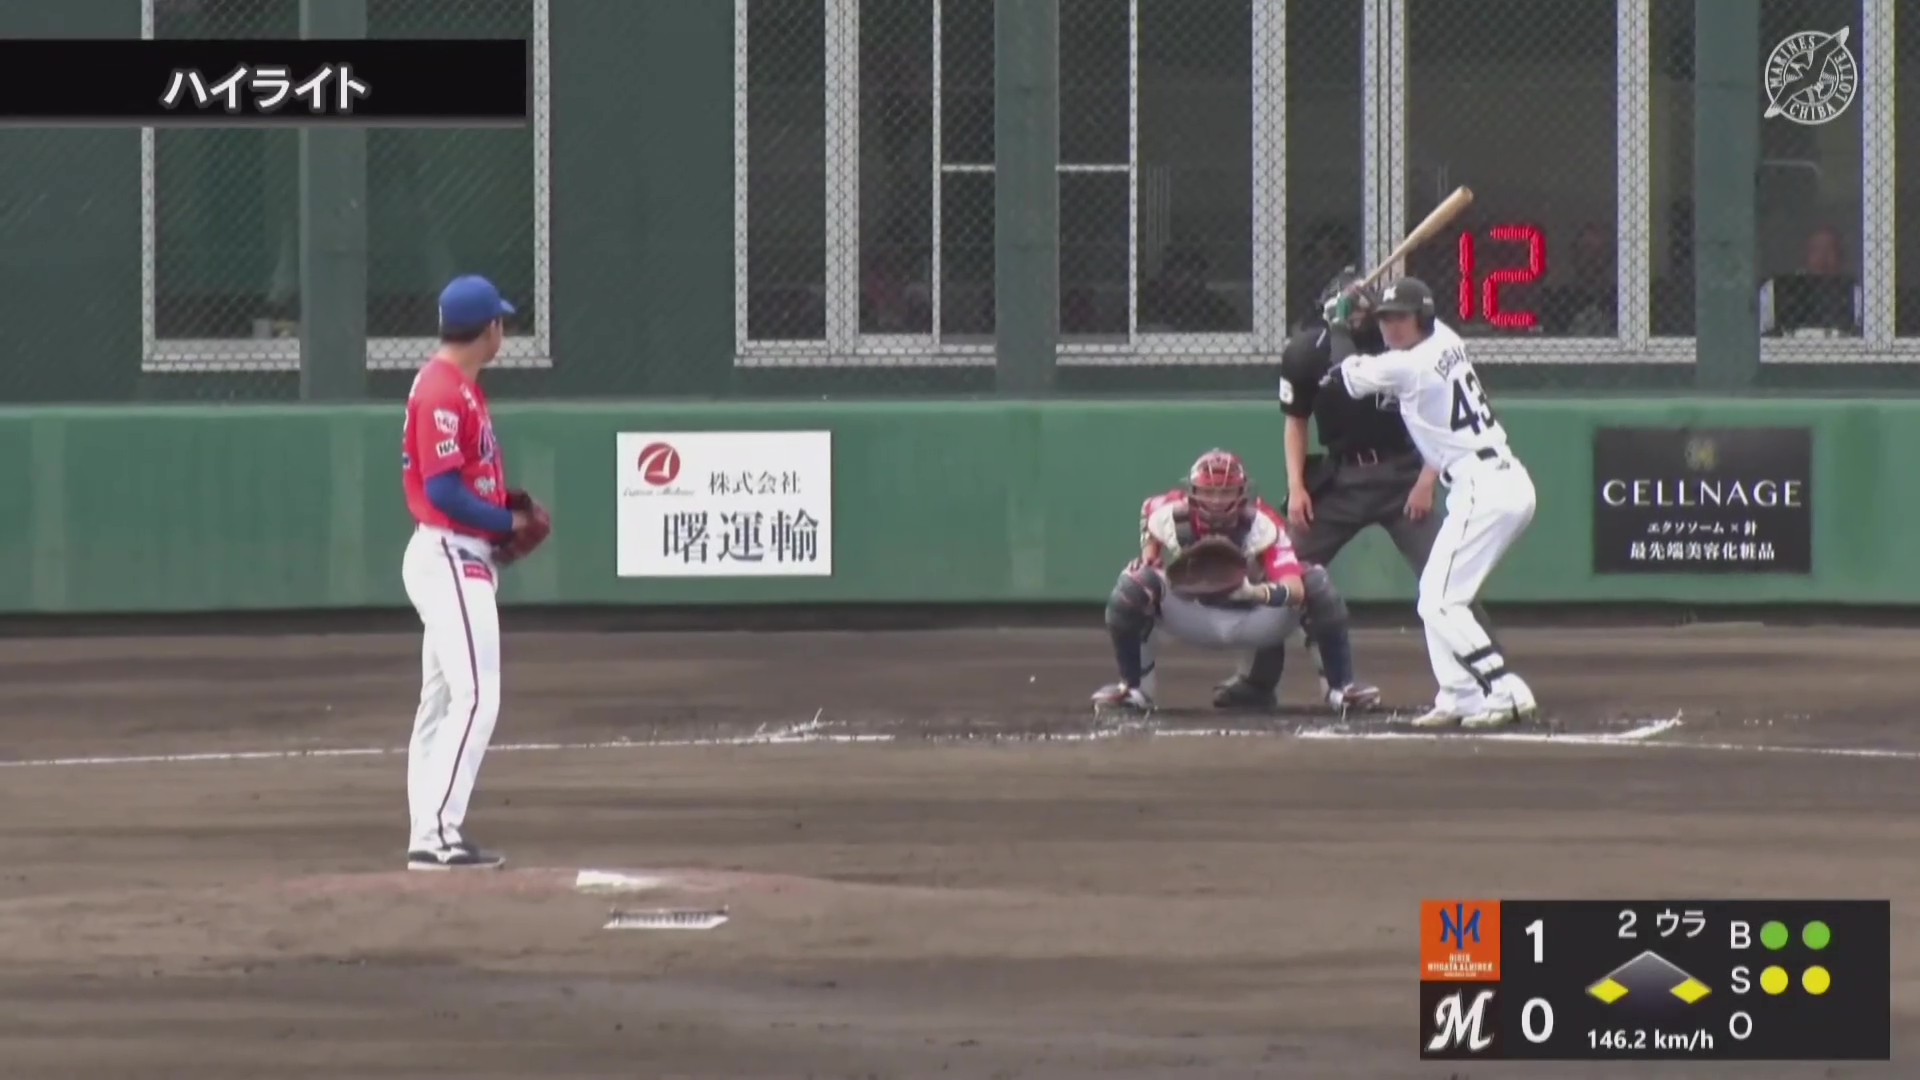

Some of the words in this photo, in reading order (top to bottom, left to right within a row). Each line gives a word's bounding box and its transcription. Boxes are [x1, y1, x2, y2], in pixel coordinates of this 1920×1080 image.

[1459, 224, 1546, 329] 12
[1450, 371, 1495, 436] 43
[708, 470, 802, 495] 株式会社
[1602, 479, 1802, 507] CELLNAGE
[663, 508, 819, 564] 曙運輸
[1630, 541, 1776, 561] 最先端美容化粧品
